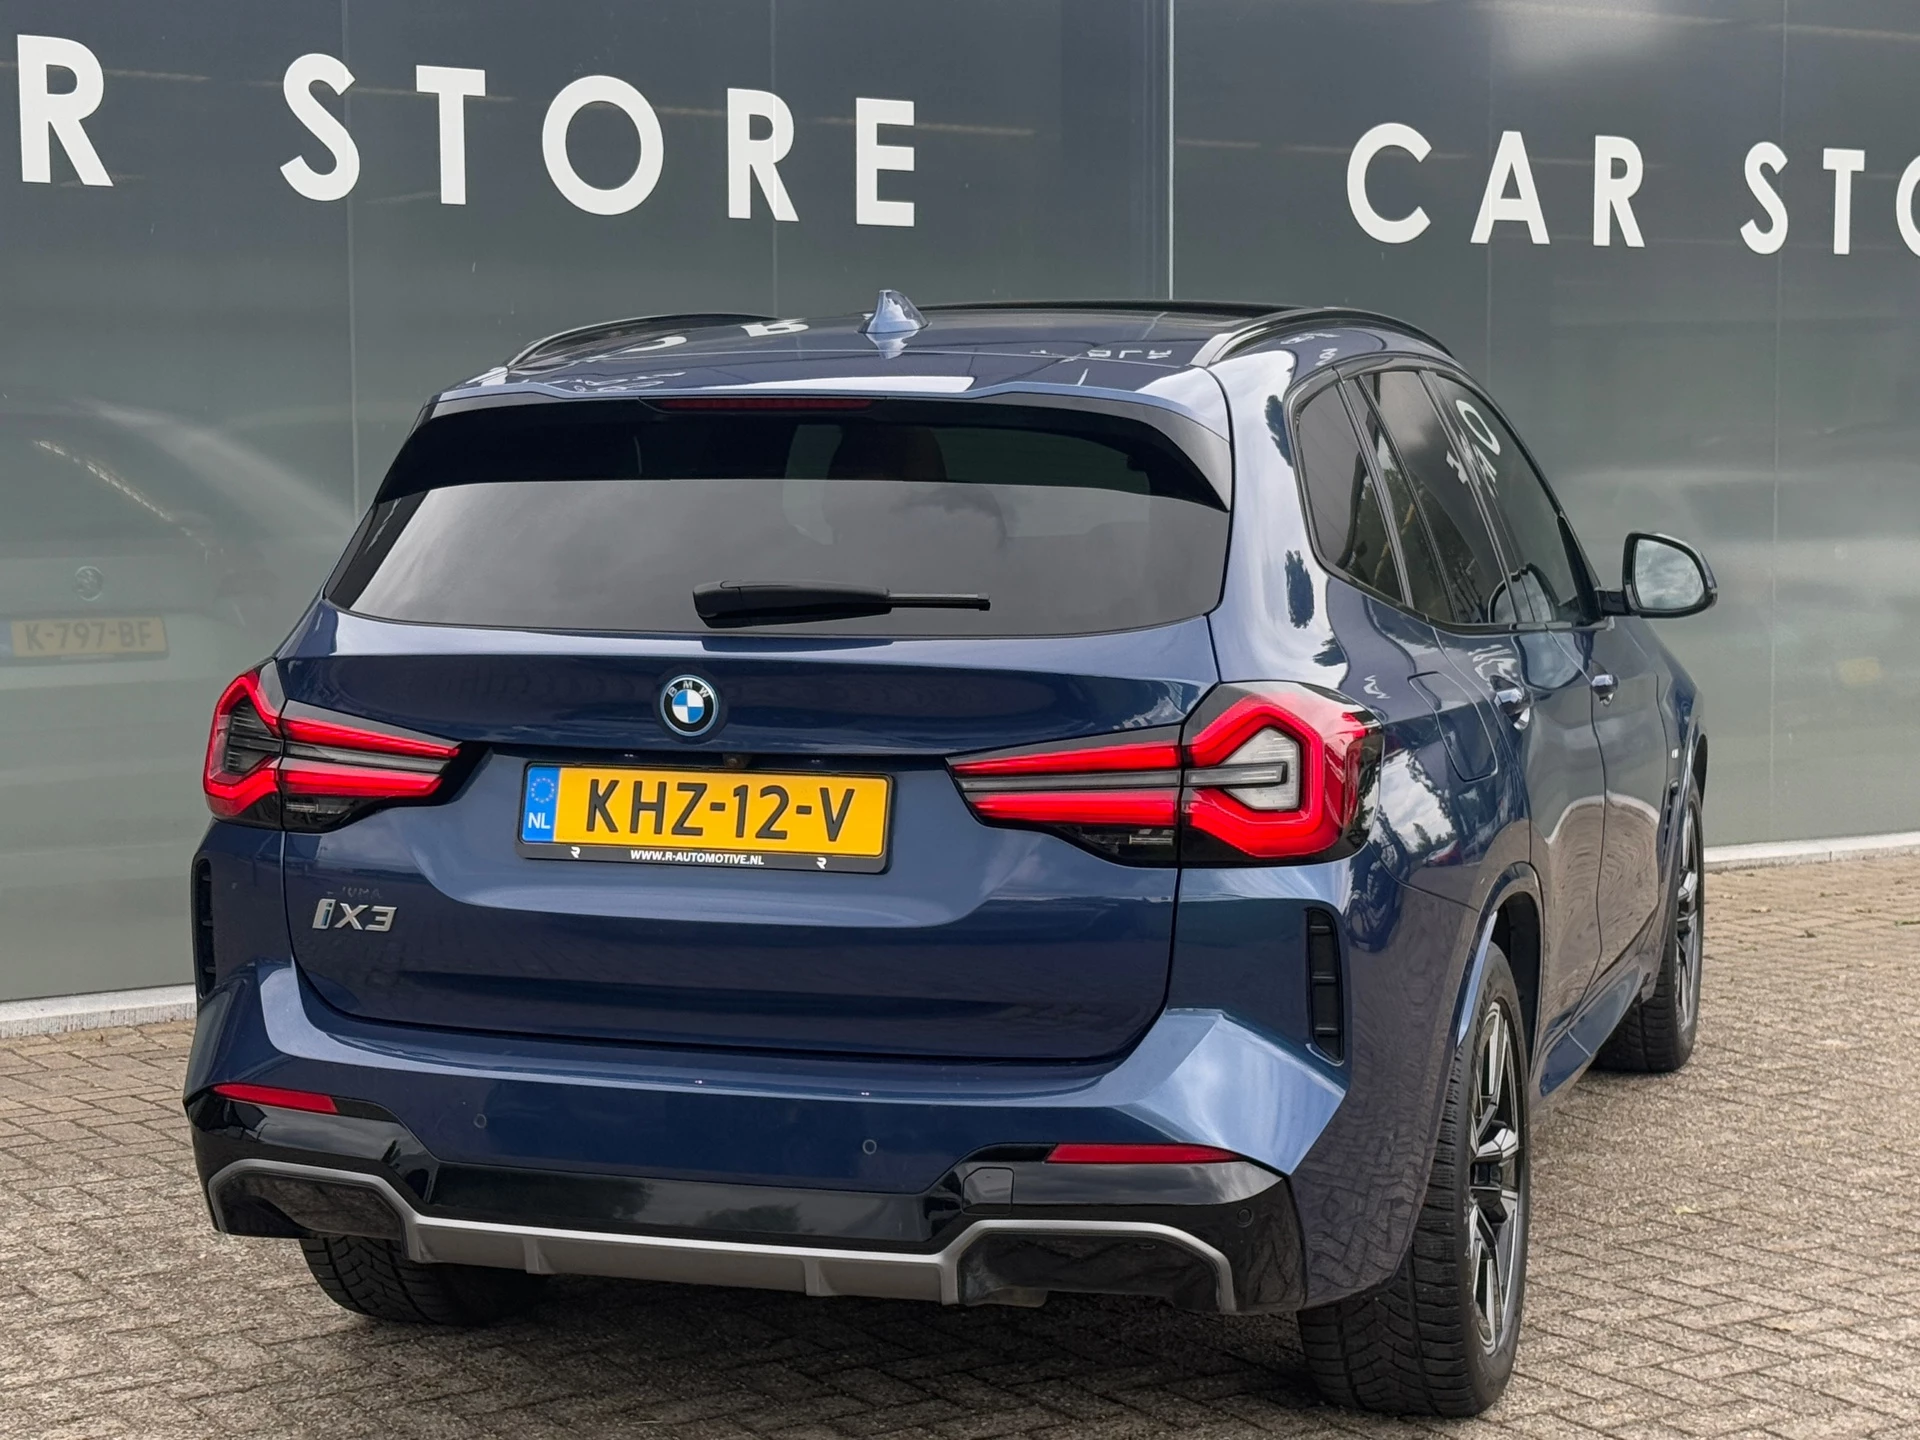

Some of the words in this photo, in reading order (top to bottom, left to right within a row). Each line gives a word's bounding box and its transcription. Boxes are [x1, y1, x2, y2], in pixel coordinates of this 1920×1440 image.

[280, 53, 915, 227] STORE
[1347, 122, 1645, 247] CAR
[24, 620, 153, 652] K-797-BF
[667, 680, 710, 698] BMW
[527, 811, 551, 830] NL
[585, 778, 856, 842] KHZ-12-V
[630, 849, 765, 866] WWW.R-AUTOMOTIVE.NL
[312, 898, 398, 932] iX3
